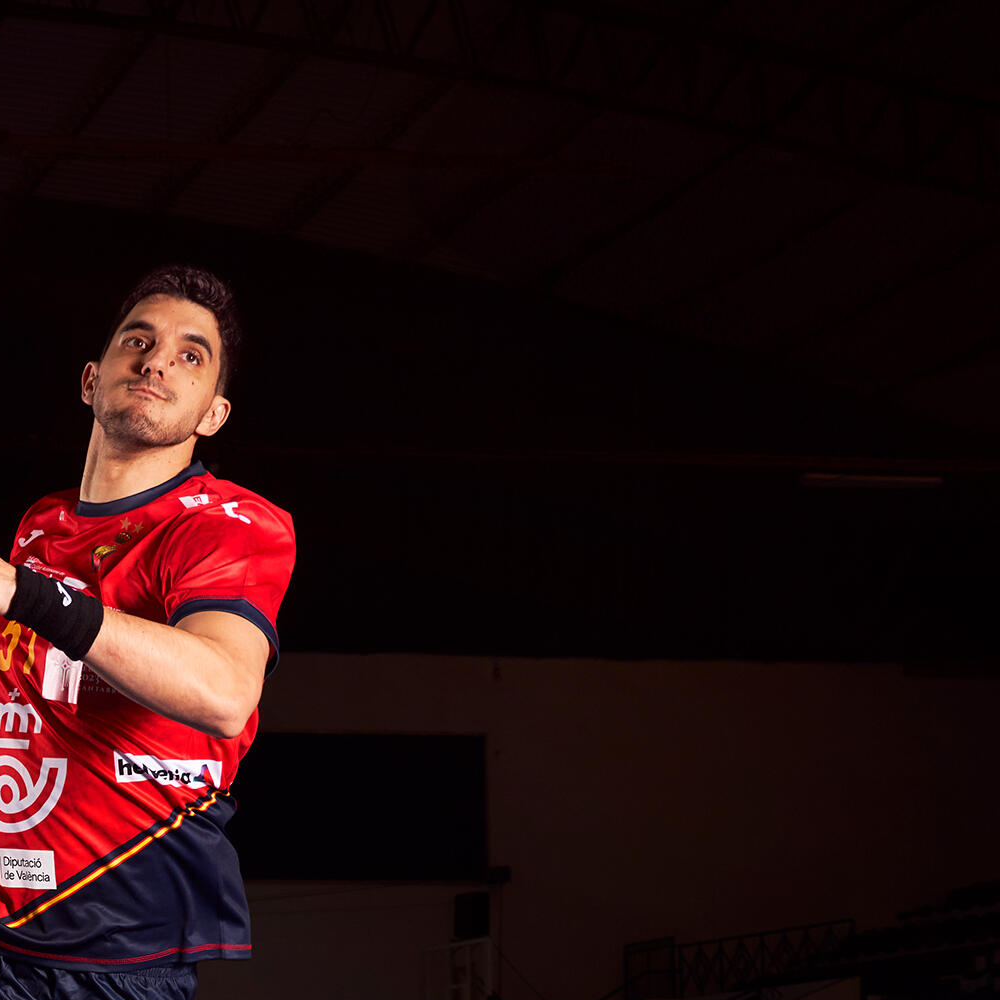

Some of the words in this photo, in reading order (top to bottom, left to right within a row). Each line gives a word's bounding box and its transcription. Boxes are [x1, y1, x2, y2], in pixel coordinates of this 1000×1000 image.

[3, 856, 42, 869] Diputació
[4, 871, 15, 881] de
[16, 870, 50, 882] València
